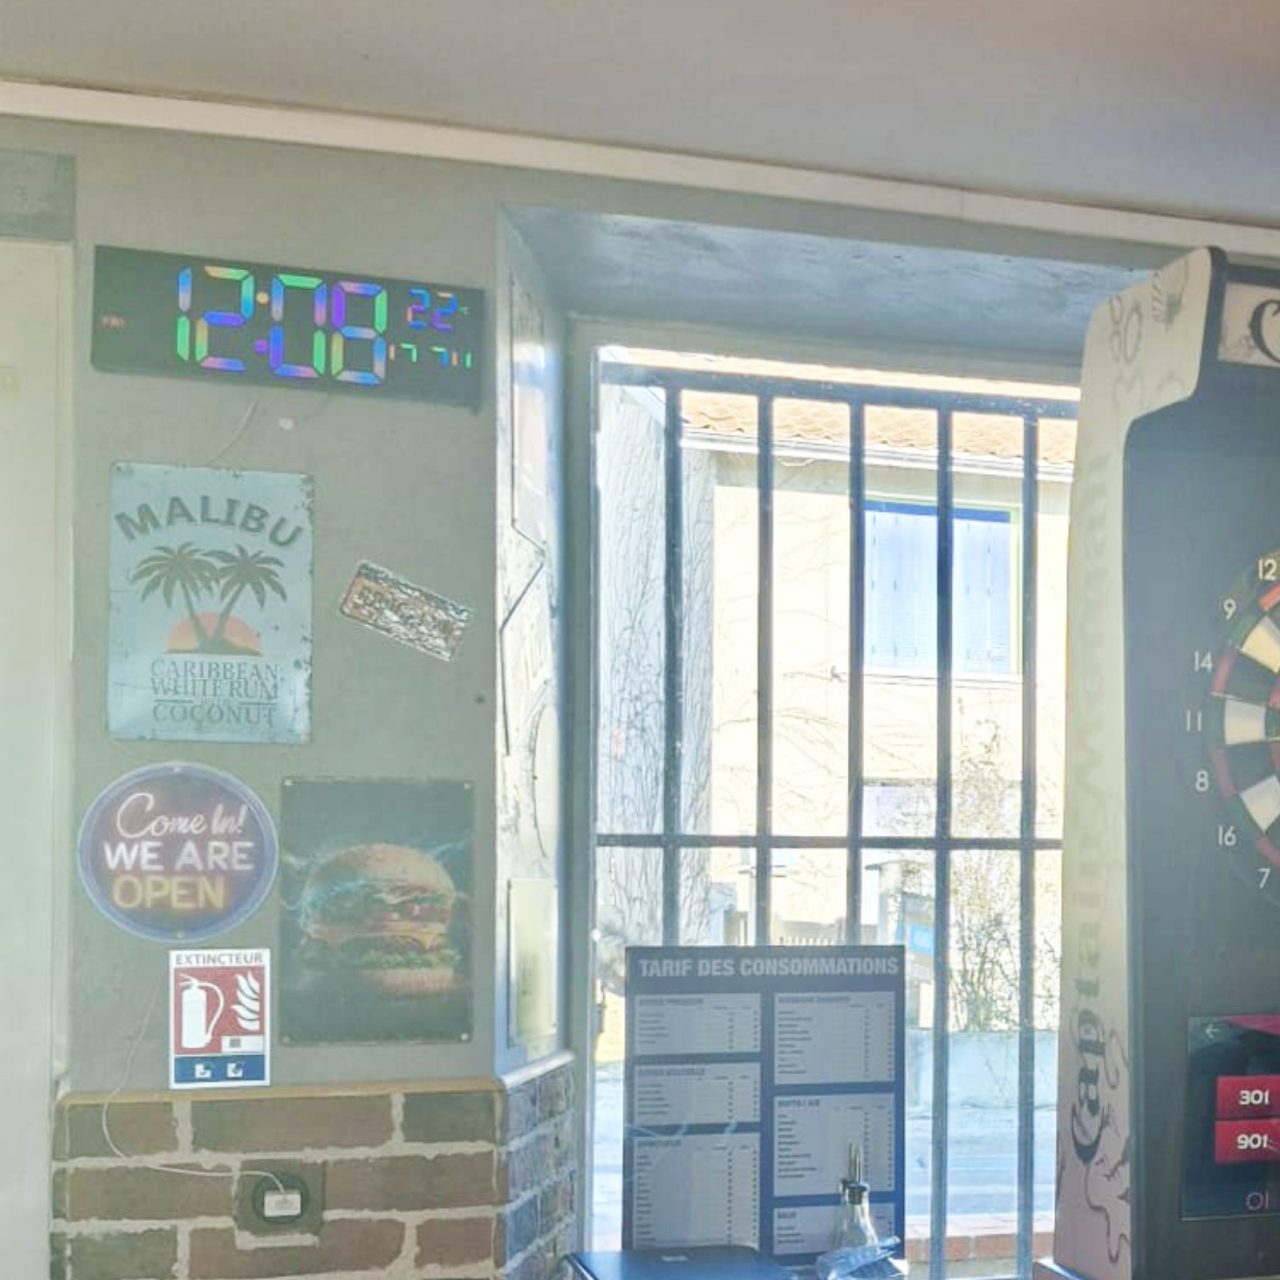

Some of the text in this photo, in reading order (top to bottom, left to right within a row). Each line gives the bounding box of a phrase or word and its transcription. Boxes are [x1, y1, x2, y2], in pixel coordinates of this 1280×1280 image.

[177, 265, 387, 386] 12:08
[114, 495, 302, 548] MALIBU
[1258, 559, 1277, 581] 12
[1223, 598, 1237, 619] 9
[151, 659, 279, 680] CARIBBEAN
[1194, 651, 1213, 672] 14
[151, 677, 279, 699] WHITE RUM
[153, 704, 275, 726] COCONUT
[1186, 711, 1203, 731] 11
[1195, 771, 1209, 792] 8
[116, 793, 206, 840] Come
[1218, 825, 1237, 846] 16
[104, 840, 256, 873] WE ARE
[1258, 868, 1271, 889] 7
[112, 873, 227, 911] OPEN
[174, 951, 264, 967] EXTINCTEUR
[638, 956, 900, 978] TARIF DES CONSOMMATIONS
[1239, 1088, 1270, 1106] 301
[1237, 1133, 1269, 1150] 901
